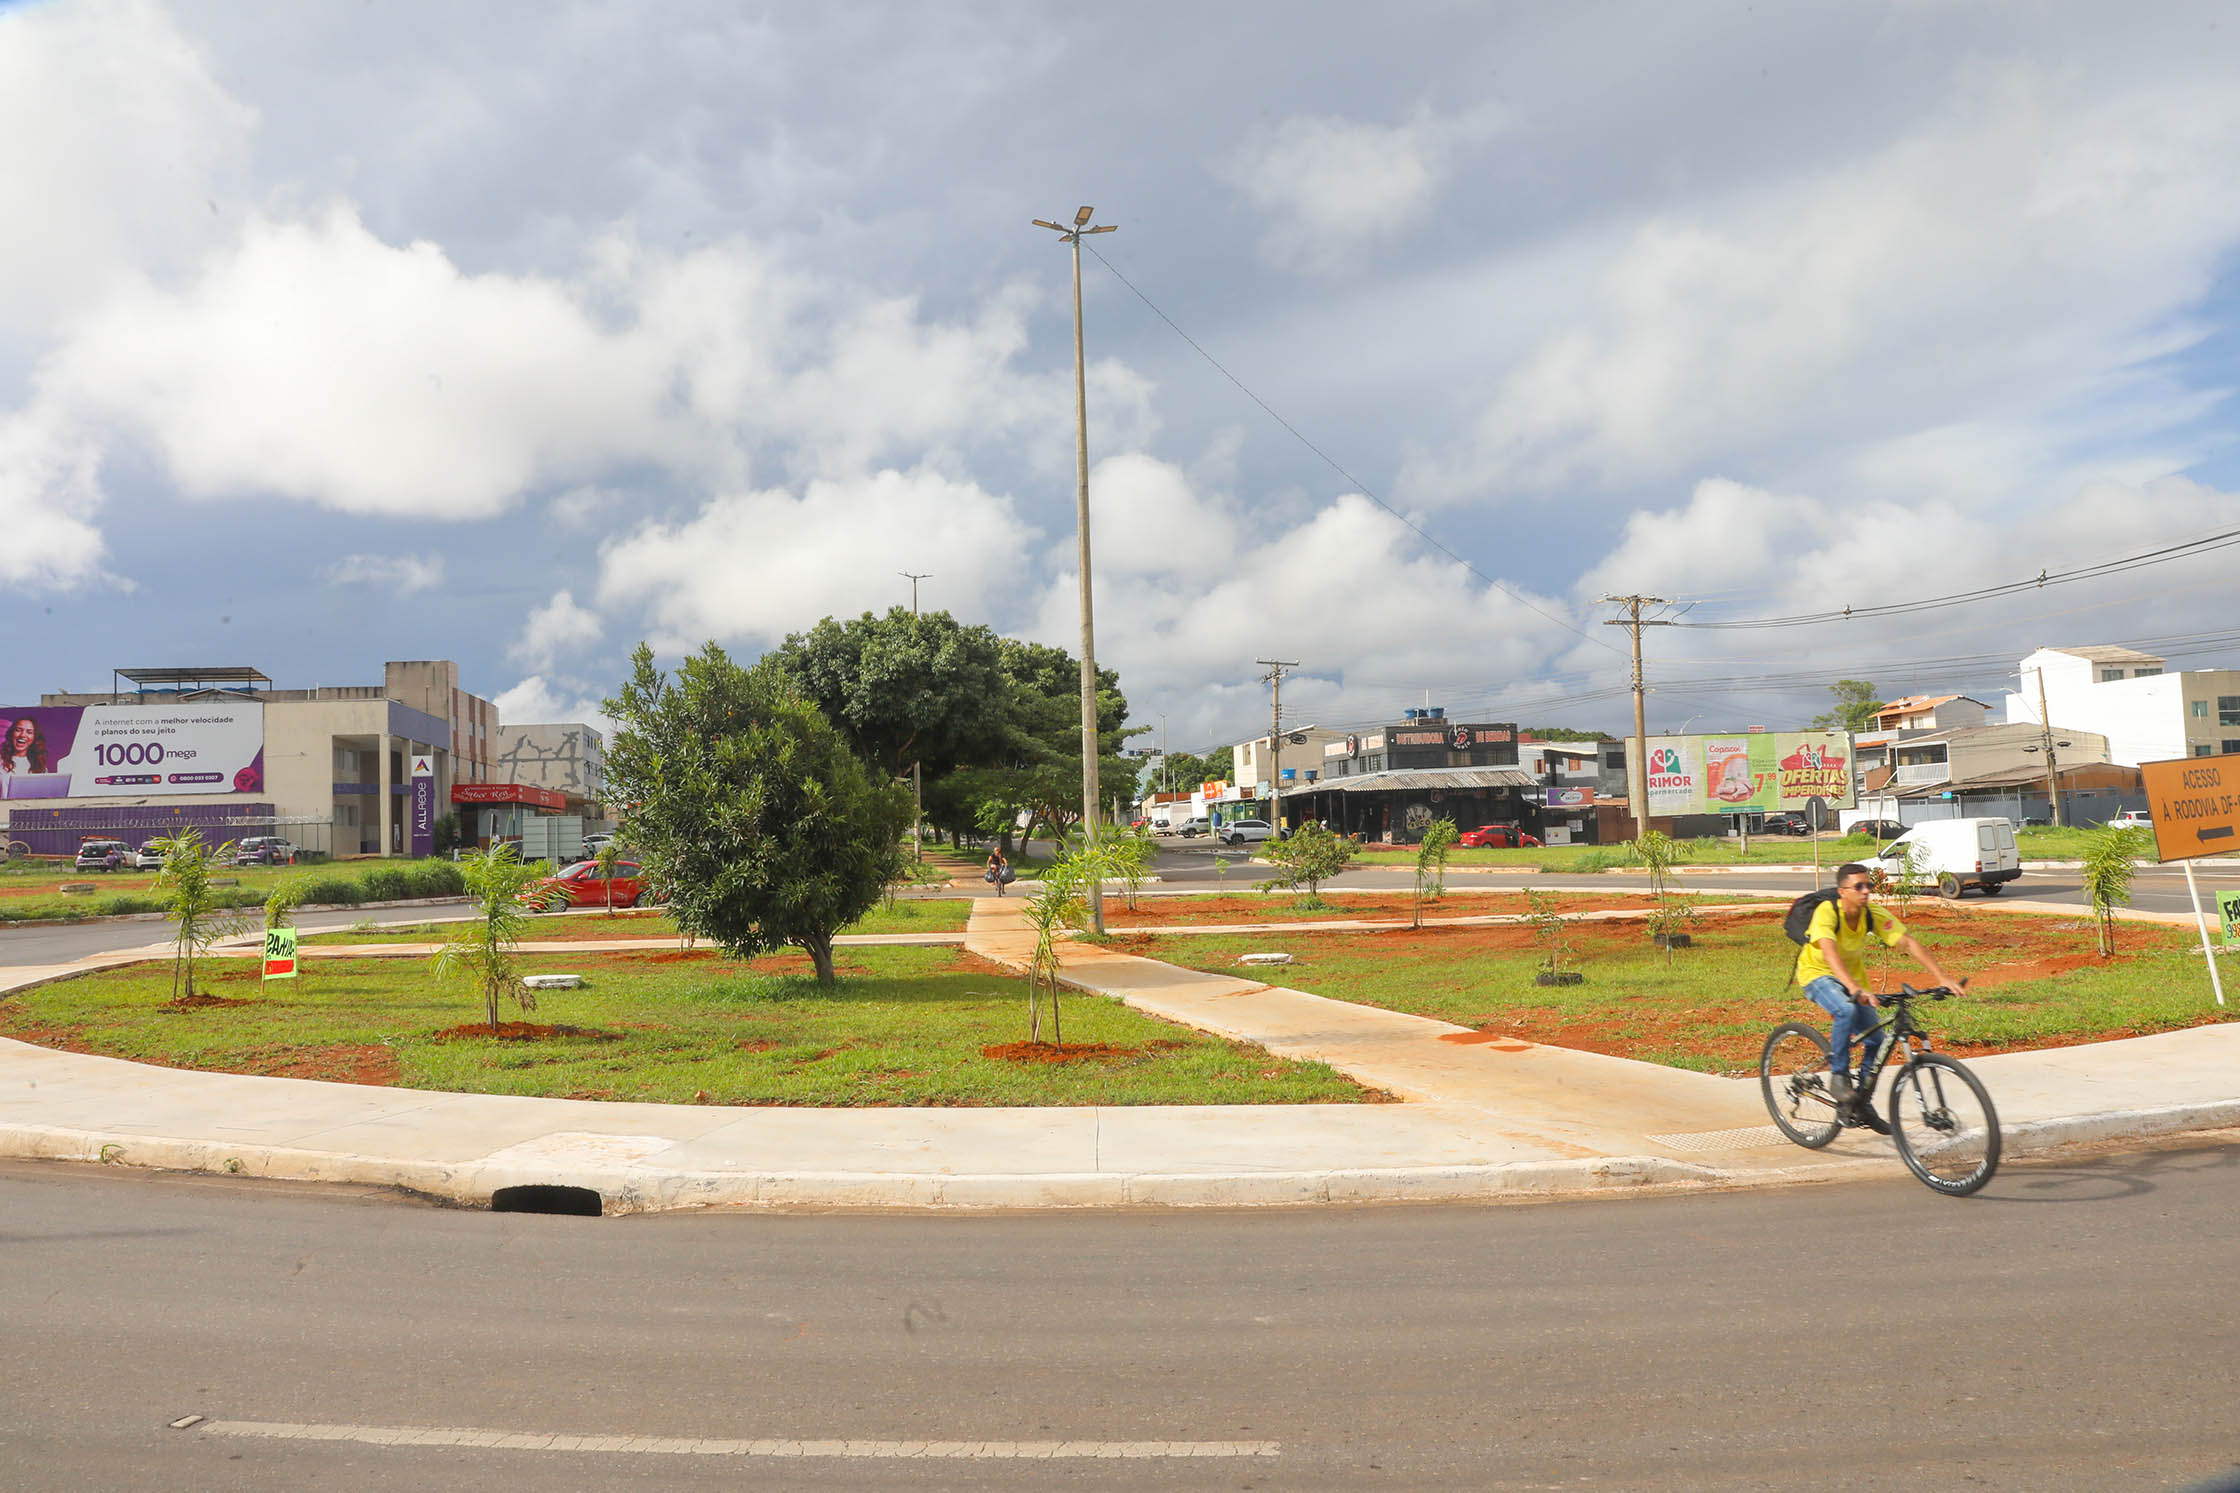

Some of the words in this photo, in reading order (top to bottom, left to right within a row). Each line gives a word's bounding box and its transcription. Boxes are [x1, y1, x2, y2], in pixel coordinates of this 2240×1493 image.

[103, 718, 134, 726] internet
[161, 717, 188, 725] melhor
[191, 716, 234, 724] velocidade
[101, 728, 128, 736] planos
[157, 727, 176, 736] jeito
[94, 742, 165, 766] 1000
[166, 749, 197, 760] mega
[1648, 776, 1692, 789] RIMOR
[1781, 769, 1849, 787] OFERTAS
[2183, 767, 2221, 790] ACESSO
[1648, 788, 1693, 797] permercado
[2173, 797, 2220, 820] RODOVIA
[2220, 794, 2240, 815] DF-
